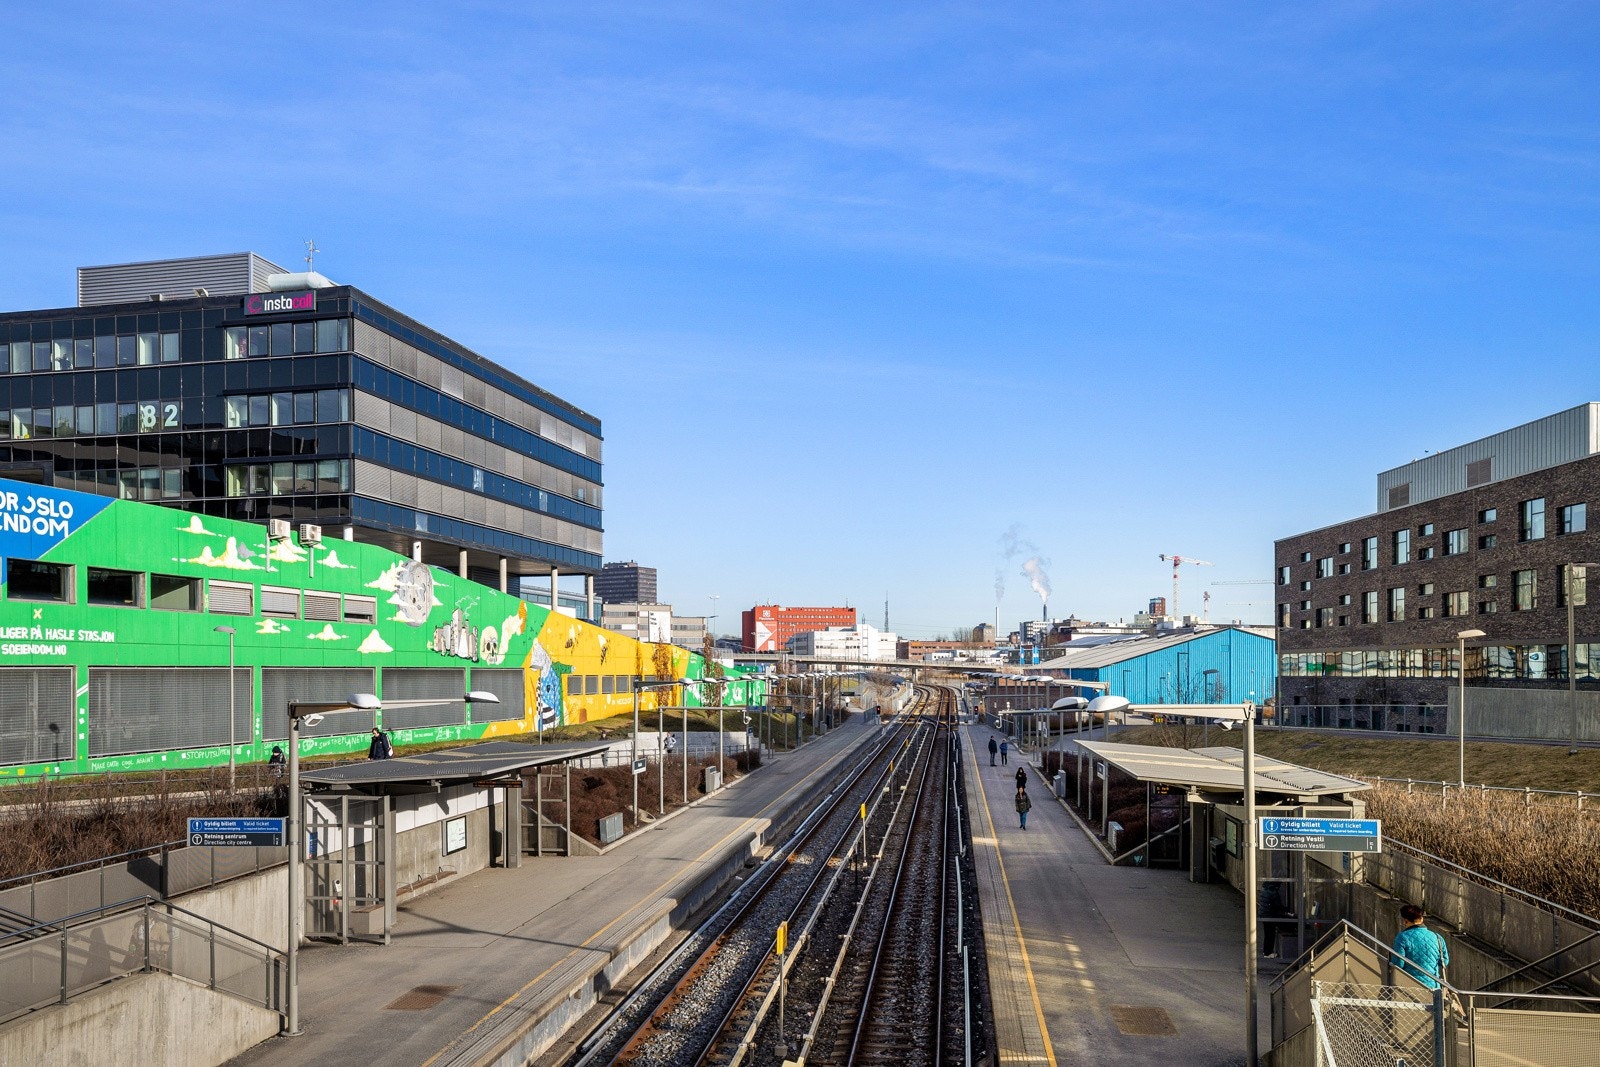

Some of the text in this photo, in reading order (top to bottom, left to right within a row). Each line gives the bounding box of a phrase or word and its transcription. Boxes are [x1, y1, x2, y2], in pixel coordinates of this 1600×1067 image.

[30, 624, 43, 640] PÅ
[45, 628, 75, 641] HASLE
[78, 629, 115, 642] STASJON
[1, 644, 67, 656] SOEIENDOM.NO
[1280, 821, 1300, 829] Gyldig
